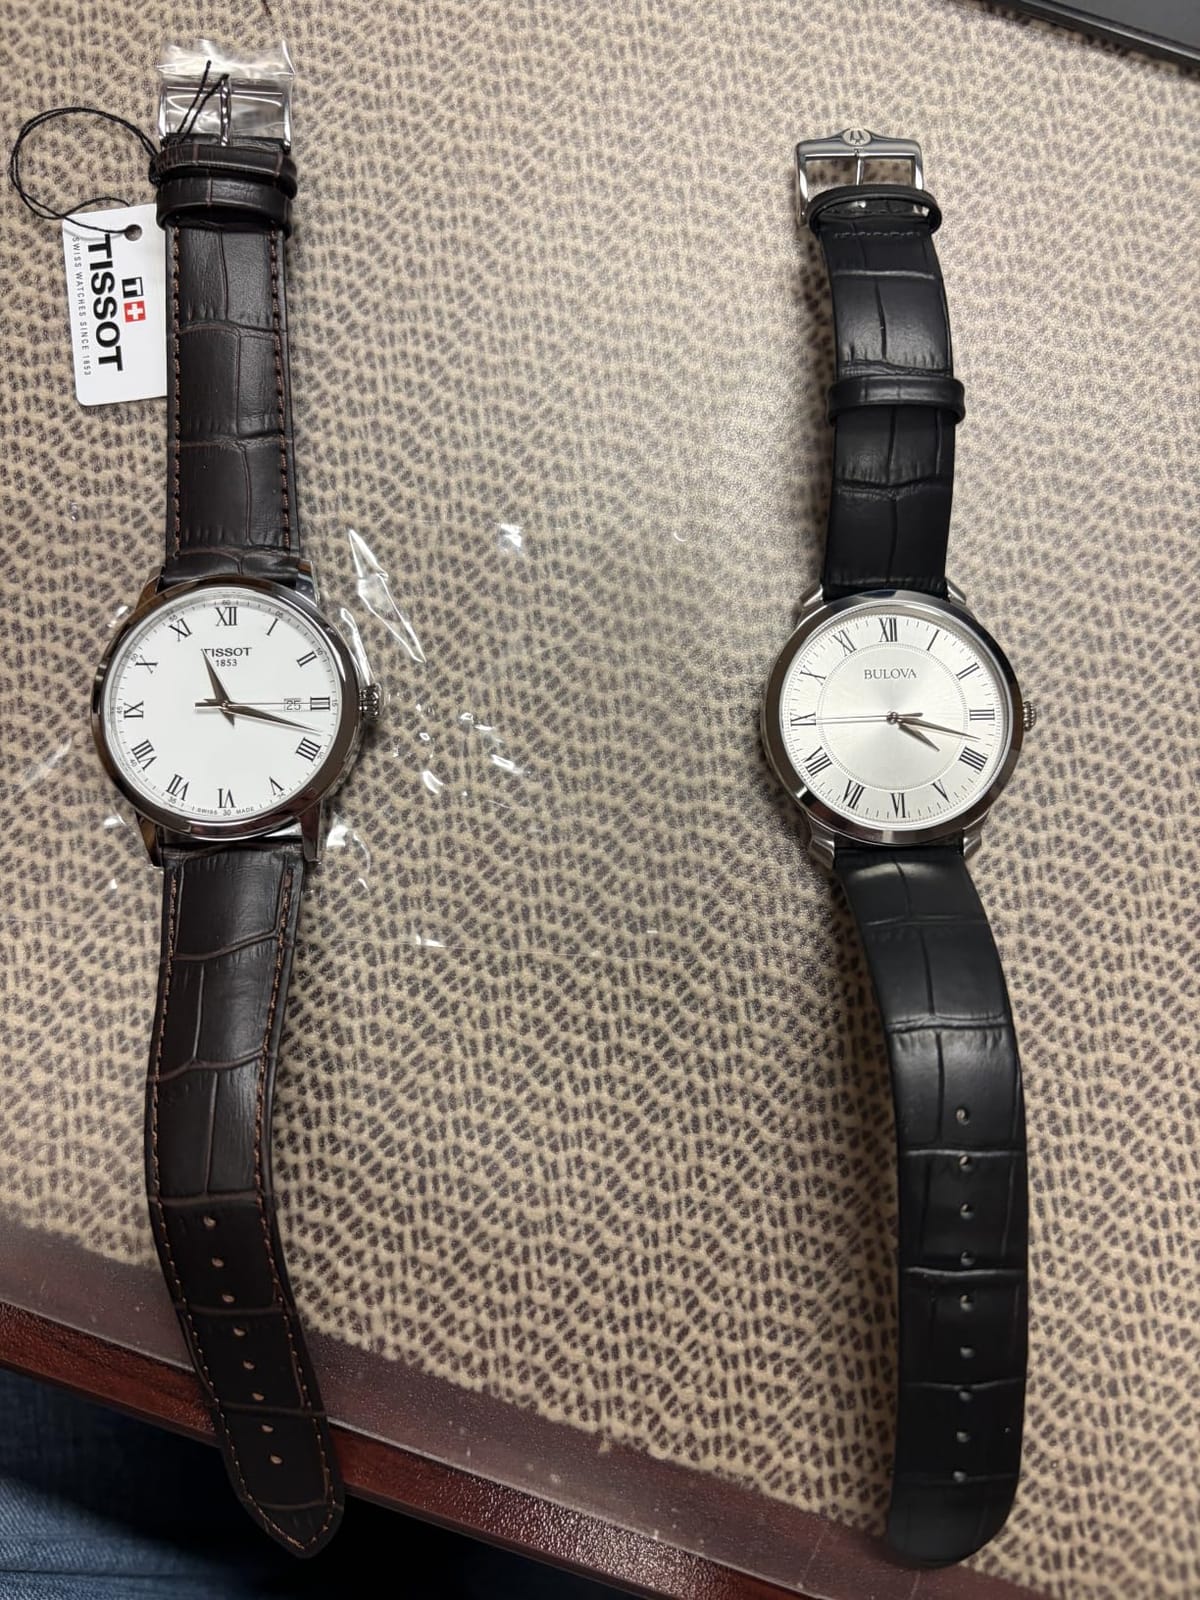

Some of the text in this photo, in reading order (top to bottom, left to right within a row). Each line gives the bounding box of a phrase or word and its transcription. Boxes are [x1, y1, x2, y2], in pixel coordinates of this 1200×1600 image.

[72, 235, 91, 375] SWISS WATCHES SINCE 1853
[88, 234, 123, 371] TISSOT
[216, 607, 237, 626] XII
[169, 618, 193, 642] XI
[879, 618, 898, 642] XII
[833, 630, 856, 656] XI
[135, 655, 157, 674] X
[216, 659, 237, 667] 1853
[297, 651, 316, 667] II
[800, 665, 825, 686] X
[864, 669, 918, 680] BULOVA
[956, 662, 979, 680] II
[124, 701, 144, 718] IX
[310, 697, 330, 711] III
[791, 712, 816, 726] IX
[969, 709, 994, 721] III
[132, 740, 158, 771] VIII
[296, 737, 322, 762] IIII
[803, 747, 833, 777] VIII
[959, 747, 987, 775] IIII
[166, 775, 188, 801] VII
[269, 777, 284, 795] V
[842, 780, 866, 809] VII
[931, 780, 950, 802] V
[218, 789, 234, 808] VI
[890, 792, 906, 818] VI
[197, 807, 218, 815] SWISS
